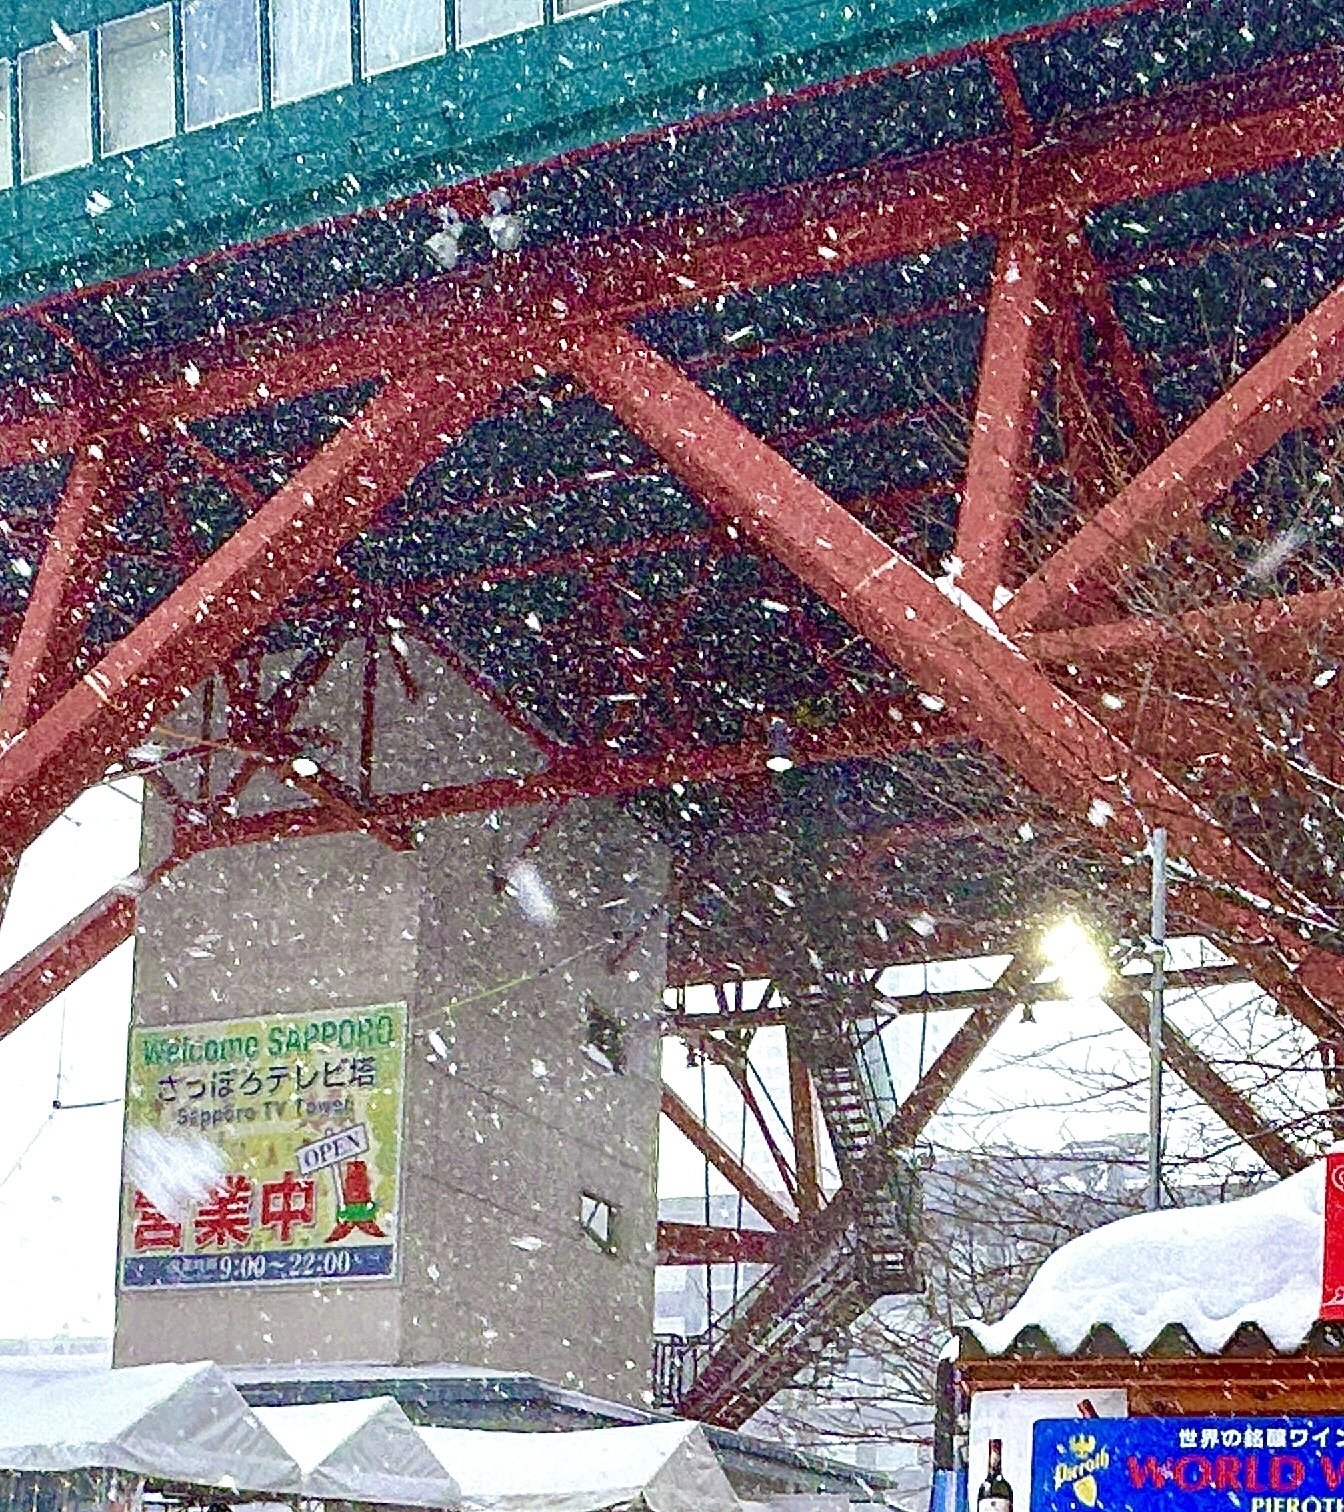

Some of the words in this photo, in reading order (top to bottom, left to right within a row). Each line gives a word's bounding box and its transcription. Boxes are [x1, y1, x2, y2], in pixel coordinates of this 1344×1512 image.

[141, 1032, 258, 1067] Welcome
[267, 1014, 394, 1057] SAPPORO
[158, 1056, 377, 1102] さっぽろテレビ塔
[260, 1100, 286, 1122] TV
[303, 1134, 362, 1168] OPEN
[1126, 1454, 1305, 1492] WORLD
